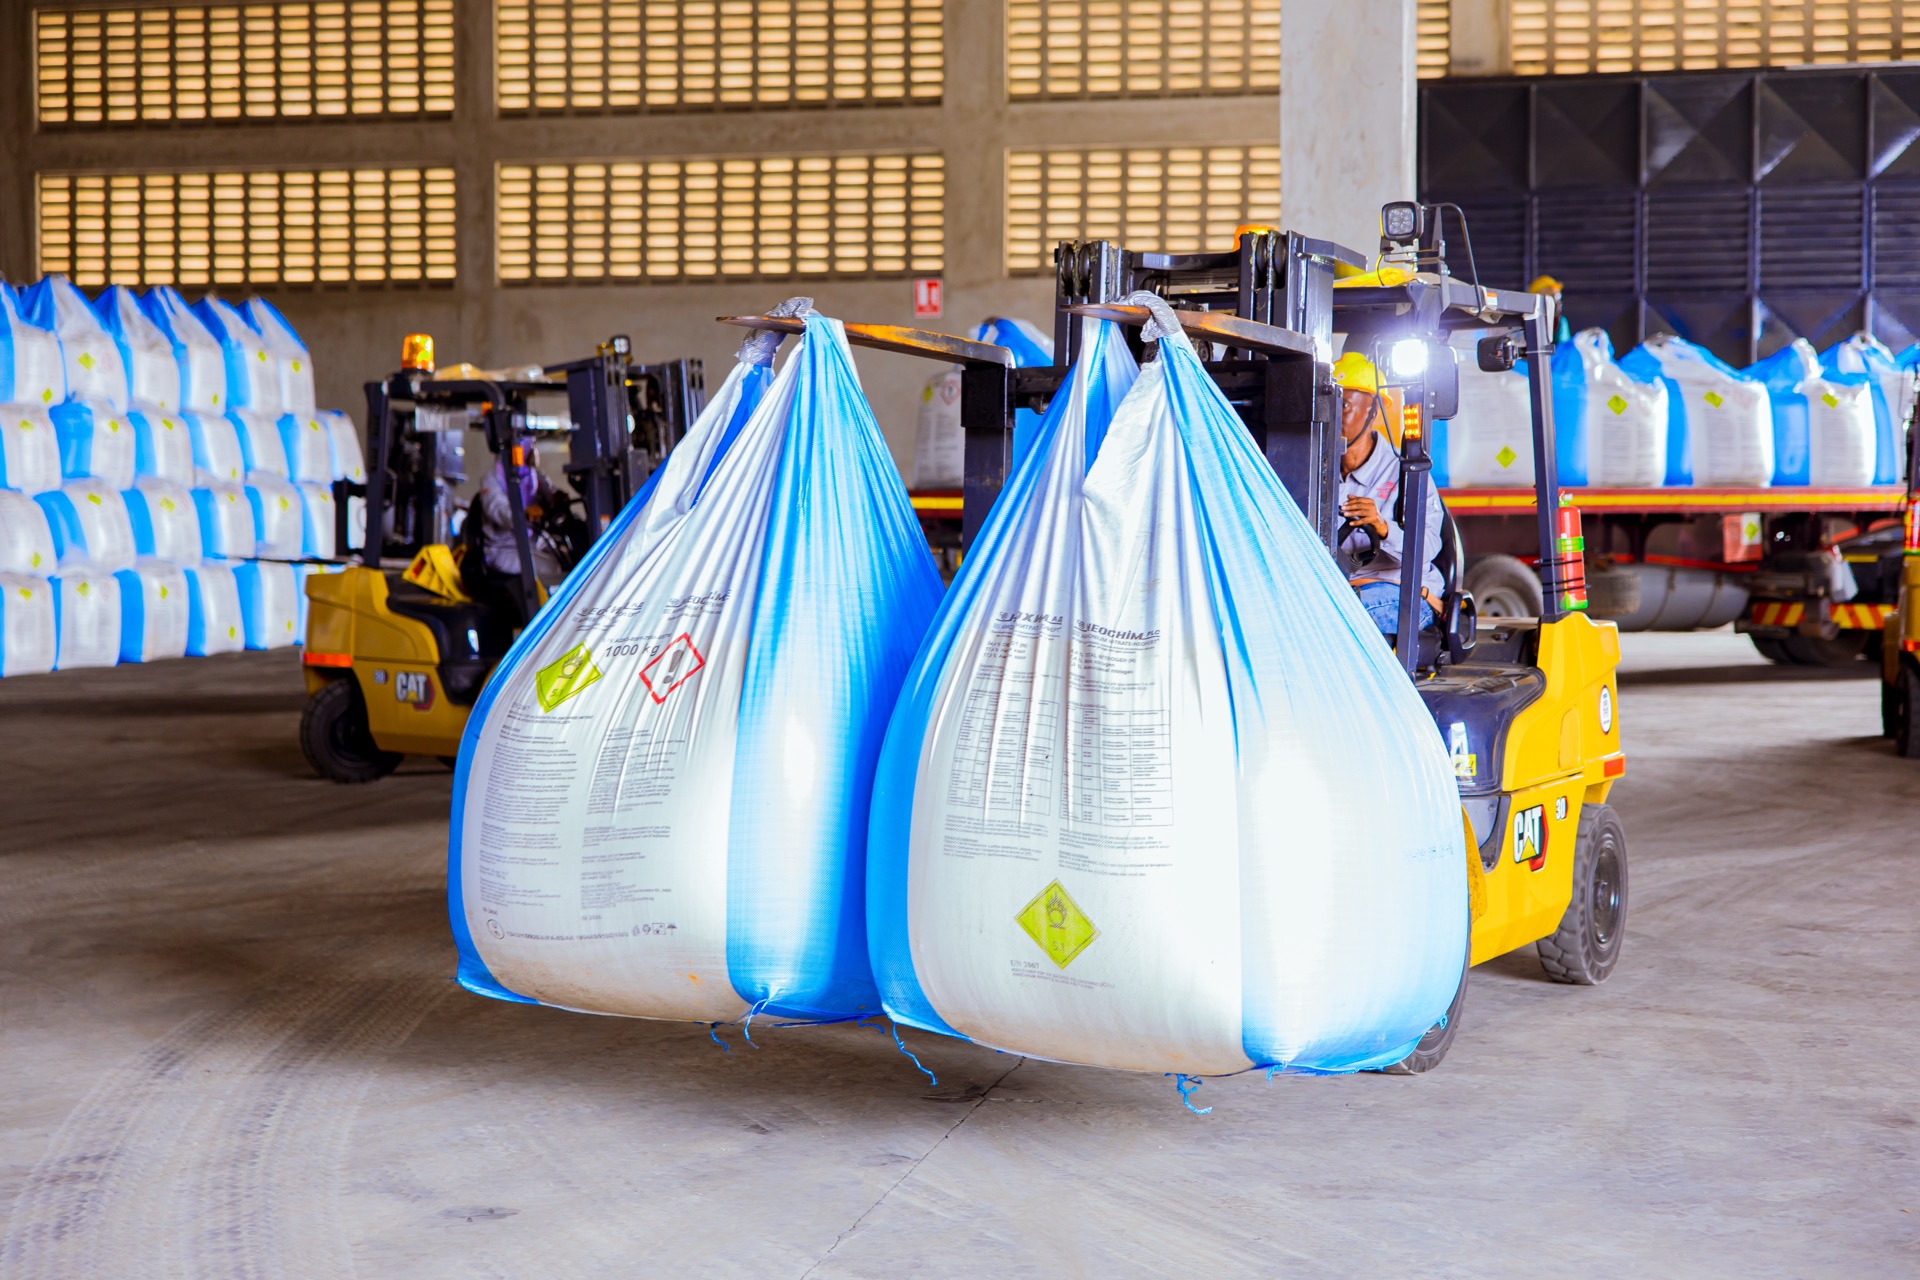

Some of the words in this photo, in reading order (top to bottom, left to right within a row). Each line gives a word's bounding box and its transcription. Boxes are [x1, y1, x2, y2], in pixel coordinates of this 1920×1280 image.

[605, 644, 639, 658] 1000
[641, 642, 660, 657] kg
[396, 671, 427, 704] CAT
[1555, 796, 1567, 821] 30
[1513, 807, 1544, 863] CAT
